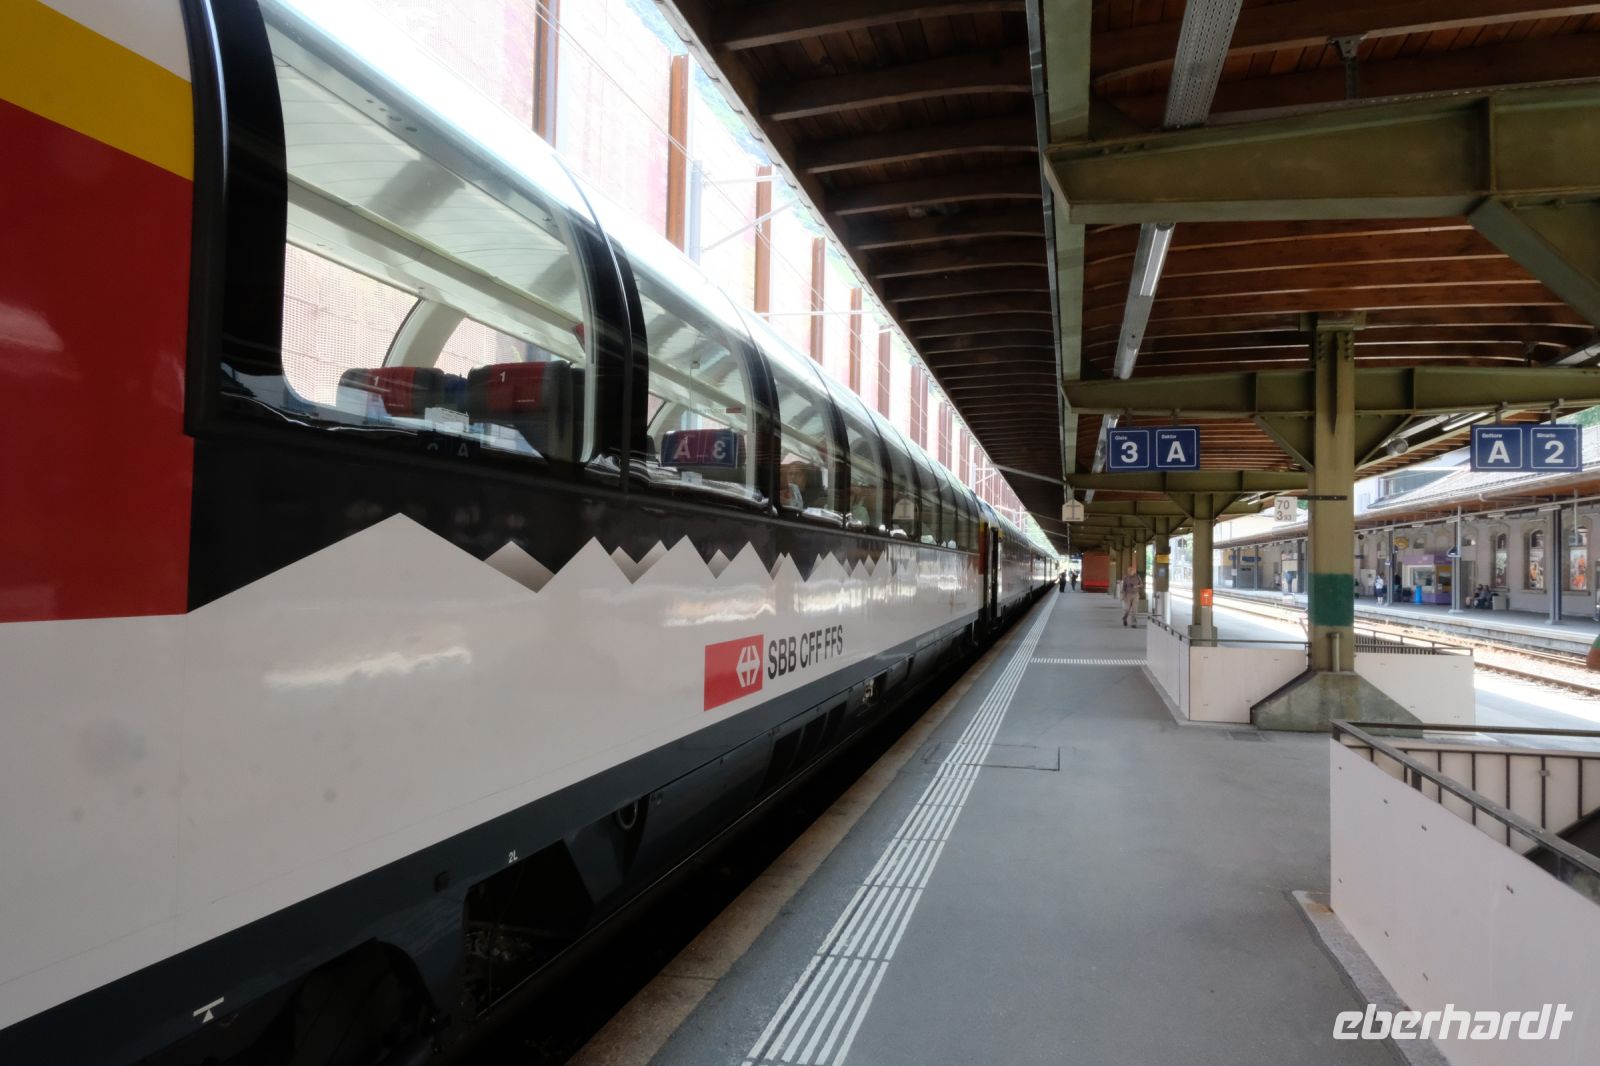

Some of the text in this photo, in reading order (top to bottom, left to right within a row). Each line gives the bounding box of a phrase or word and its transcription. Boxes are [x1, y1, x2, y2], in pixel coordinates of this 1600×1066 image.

[372, 376, 379, 386] 1
[500, 371, 506, 382] 1
[1121, 441, 1187, 463] 3 A
[1487, 440, 1565, 464] A 2
[1277, 500, 1290, 510] 70
[767, 624, 843, 680] SBB CFF FFS
[508, 849, 519, 864] 2L
